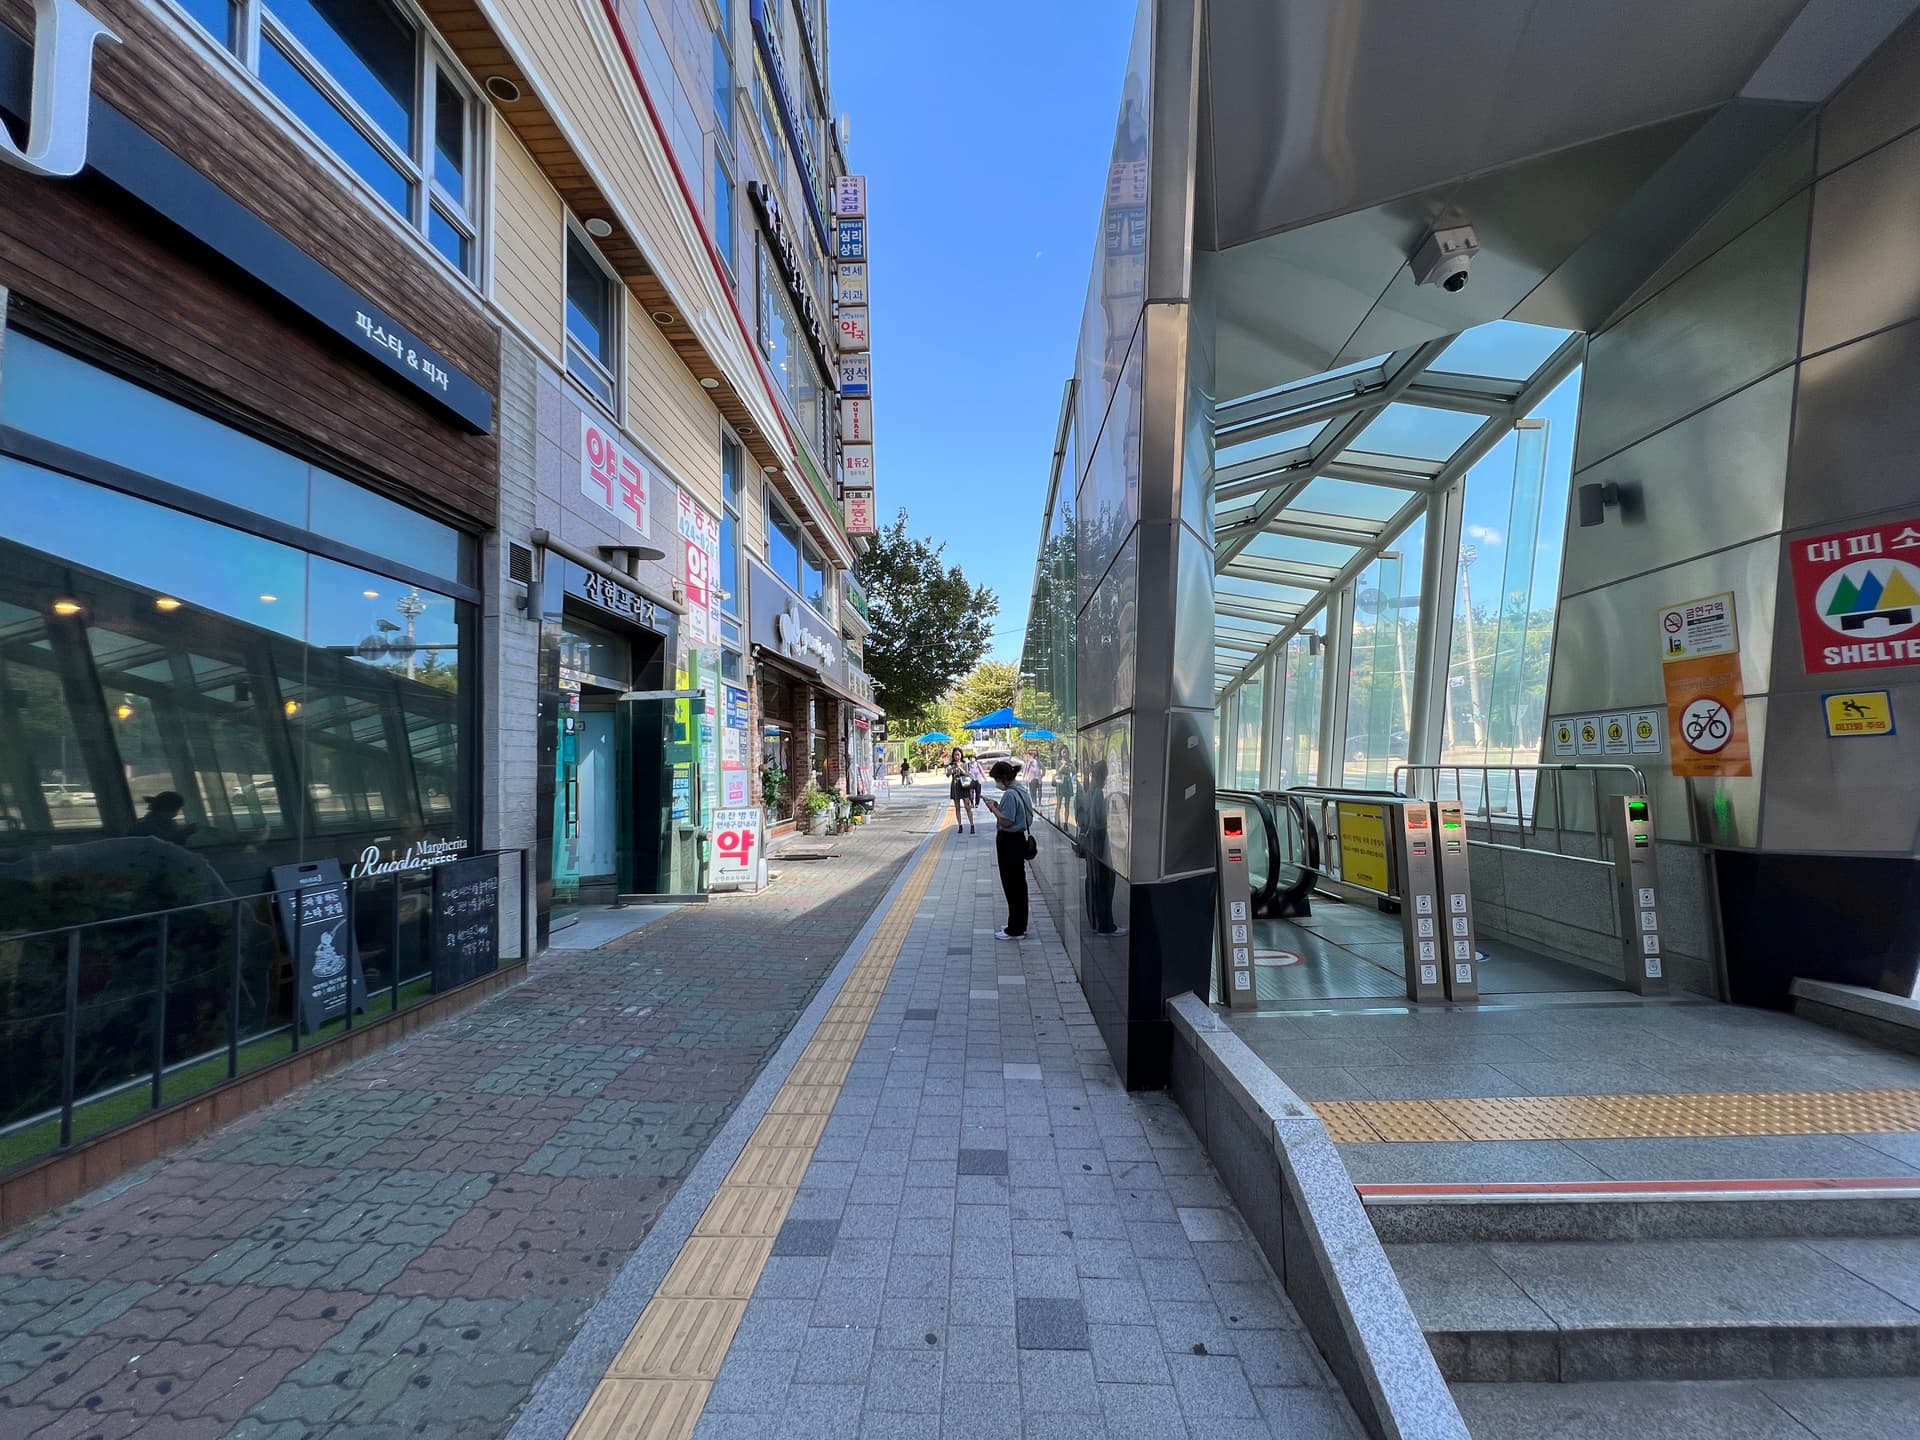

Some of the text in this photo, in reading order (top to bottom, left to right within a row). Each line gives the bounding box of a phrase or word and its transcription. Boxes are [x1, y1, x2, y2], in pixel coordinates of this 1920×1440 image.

[840, 229, 862, 242] 심리
[840, 243, 863, 256] 상담
[841, 265, 863, 277] 연세
[841, 290, 863, 301] 치과
[841, 320, 865, 341] 약국
[355, 310, 449, 391] 파스타 & 피자
[843, 367, 867, 381] 정석
[586, 427, 646, 532] 약국
[679, 489, 718, 543] 부동산
[851, 499, 868, 526] 부동산
[1807, 527, 1920, 562] 대피소
[688, 546, 707, 604] 약
[1686, 601, 1724, 619] 금연구역
[416, 835, 468, 856] Margherita
[717, 829, 754, 867] 약
